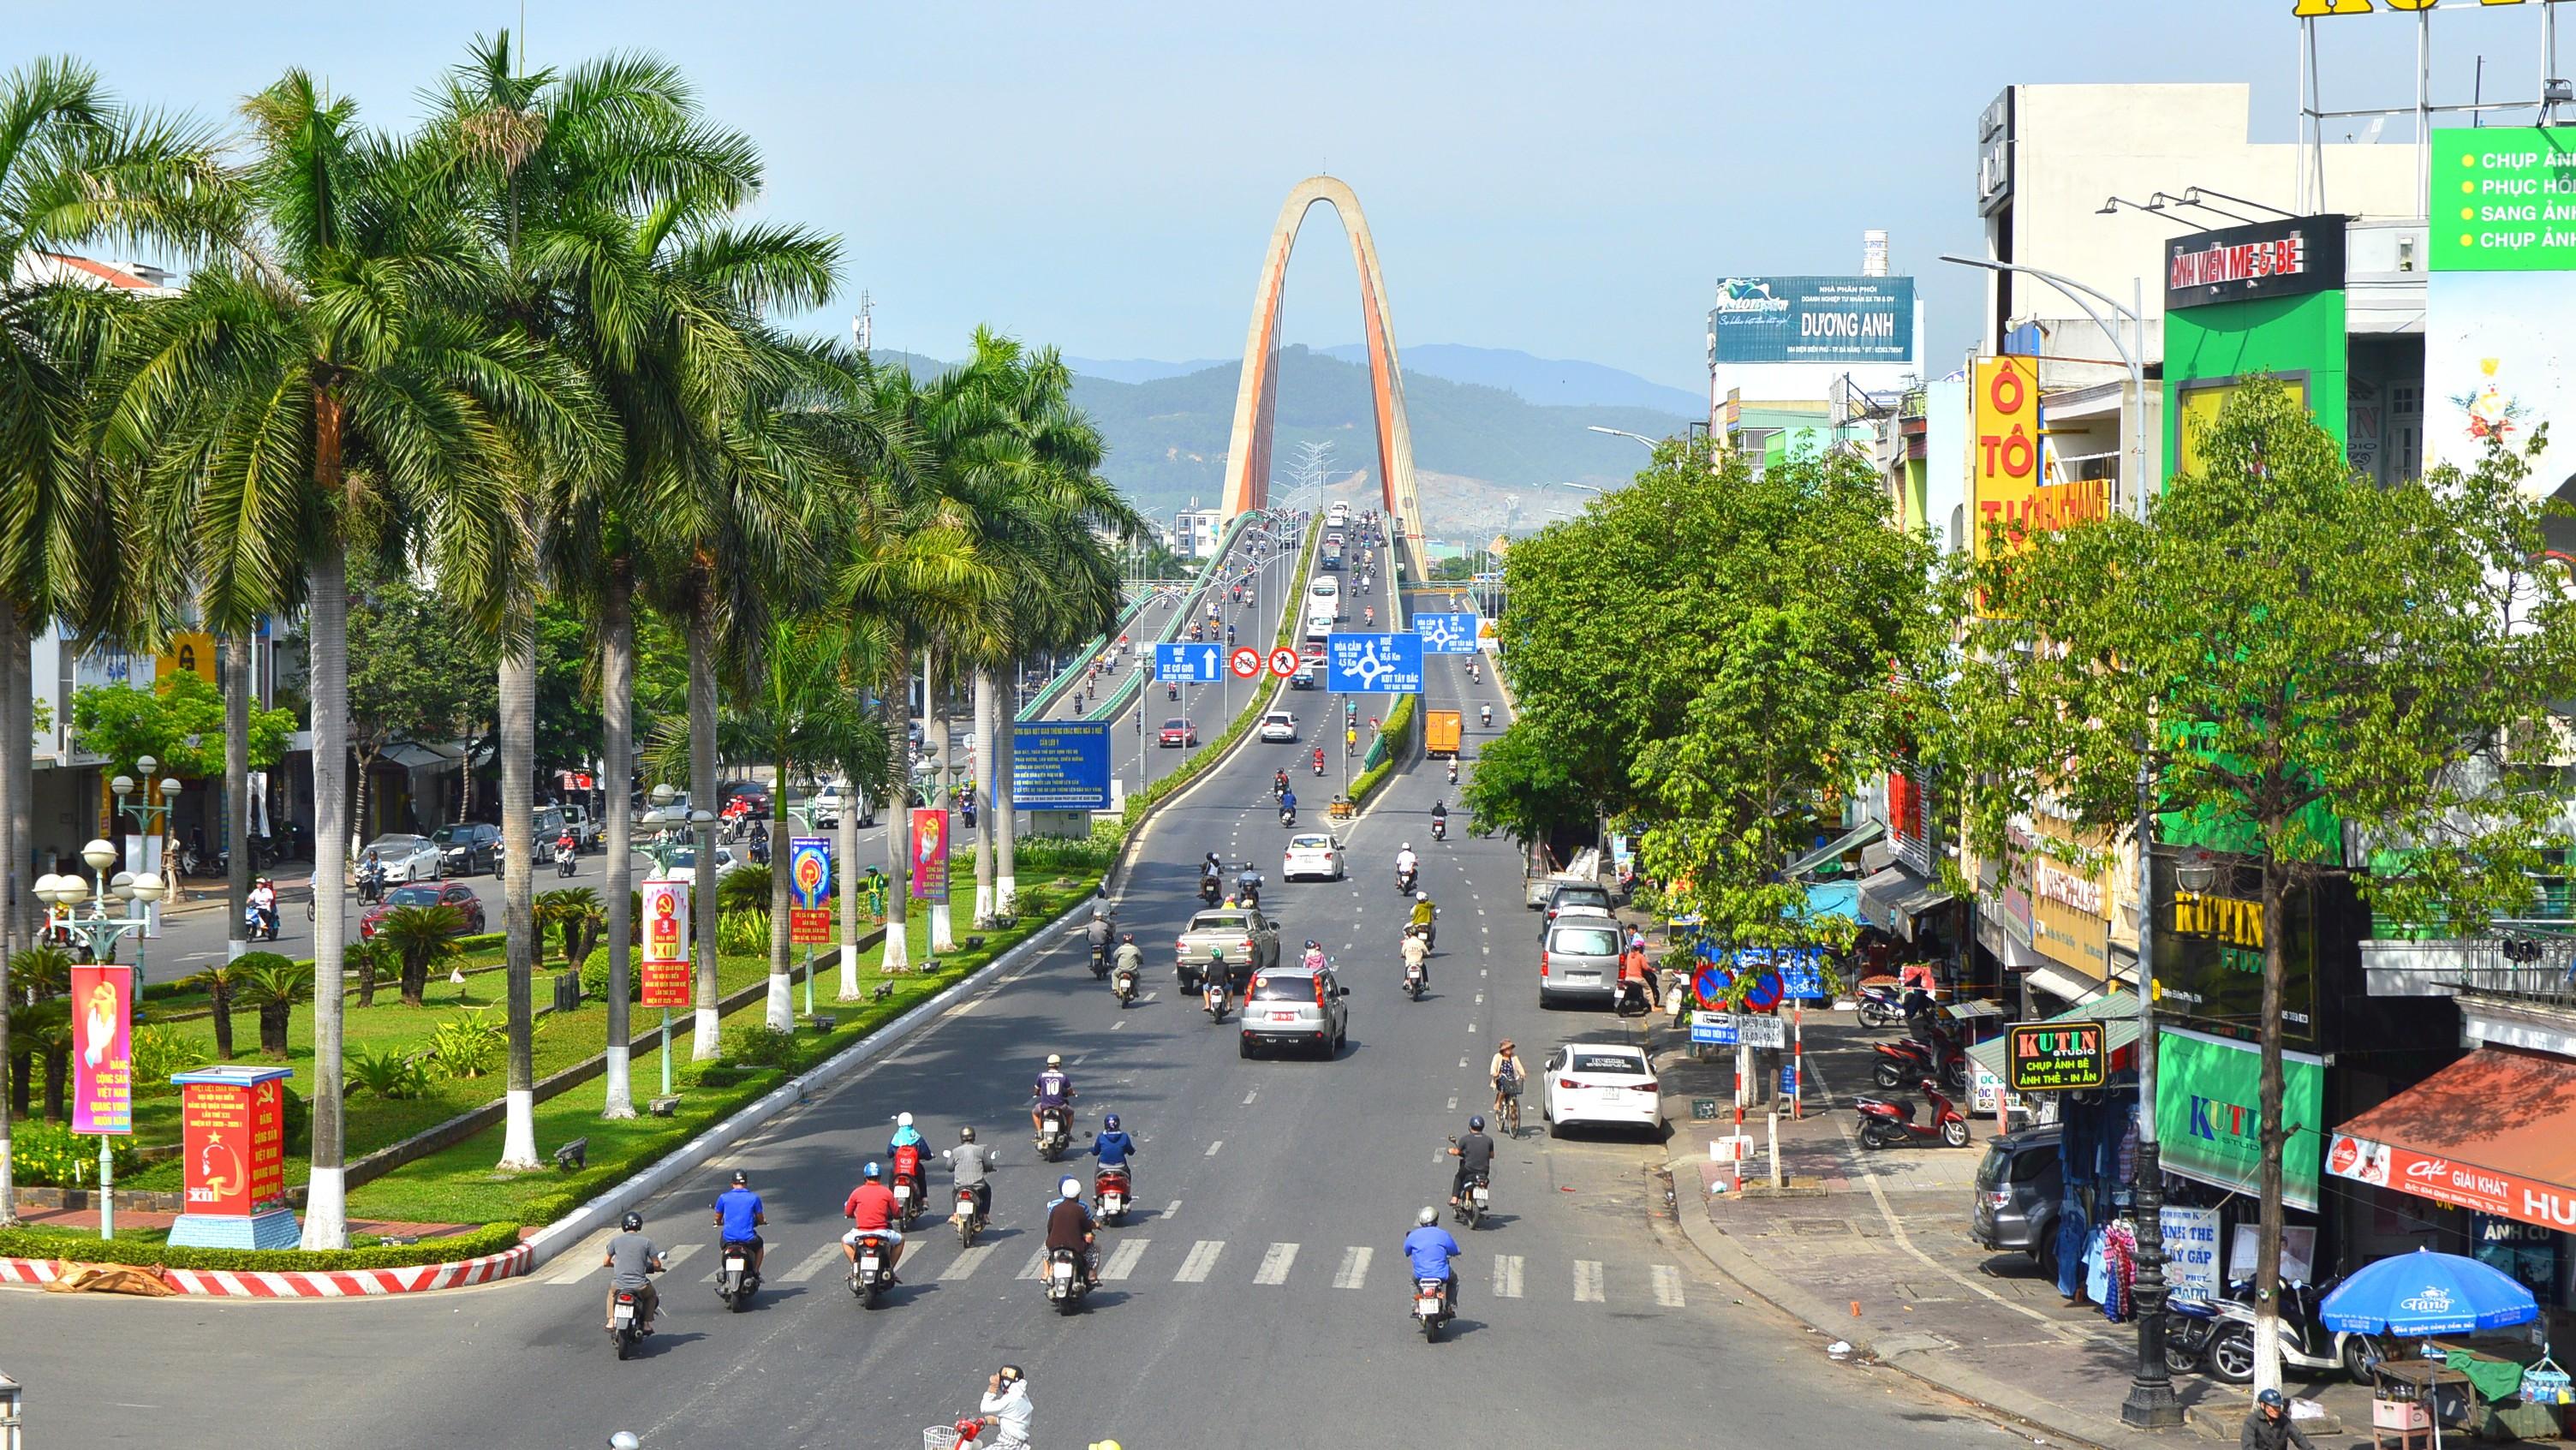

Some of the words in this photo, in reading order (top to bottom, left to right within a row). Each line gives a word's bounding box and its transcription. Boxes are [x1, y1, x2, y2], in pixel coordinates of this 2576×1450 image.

[2482, 152, 2537, 170] CHỤP
[2482, 179, 2537, 198] PHỤC
[2481, 206, 2537, 221] SANG
[2480, 232, 2536, 250] CHỤP
[2257, 243, 2271, 277] &
[2275, 231, 2299, 275] BÉ
[1801, 312, 1858, 337] DƯƠNG
[1861, 313, 1893, 337] ANH
[1849, 345, 1860, 354] NẴNG
[1991, 361, 2024, 413] Ô
[1981, 424, 2034, 479] TÔ
[1348, 640, 1362, 651] CẦM
[1380, 635, 1392, 646] HUẾ
[1173, 645, 1185, 656] HUẾ
[1392, 653, 1401, 661] Km
[1163, 664, 1172, 673] XE
[1172, 664, 1181, 673] CƠ
[1182, 662, 1194, 673] GIỚI
[1348, 658, 1357, 667] Km
[1394, 672, 1405, 683] TÂY
[1406, 671, 1418, 683] BẮC
[2174, 891, 2263, 948] KUTIN
[2221, 947, 2267, 975] STUDI
[2018, 1030, 2097, 1058] KUTIN
[2053, 1048, 2096, 1057] STUDIO
[110, 1056, 128, 1070] ĐẢNG
[2026, 1061, 2053, 1072] CHỤP
[2054, 1057, 2075, 1069] ẢNH
[96, 1073, 114, 1084] CỘNG
[114, 1071, 128, 1083] SẢN
[2020, 1073, 2041, 1085] ẢNH
[2042, 1071, 2061, 1083] THẺ
[2070, 1073, 2080, 1083] IN
[97, 1085, 112, 1098] VIỆT
[113, 1088, 128, 1098] NAM
[1045, 1078, 1060, 1095] 10
[90, 1101, 111, 1113] QUANG
[2189, 1095, 2261, 1142] KUTI
[2221, 1137, 2260, 1151] STUD
[2406, 1159, 2448, 1182] Café
[2452, 1167, 2476, 1190] GIẢI
[2478, 1176, 2508, 1198] KHÁT
[2434, 1189, 2450, 1199] Điện
[2450, 1193, 2466, 1203] Biên
[2162, 1220, 2186, 1240] ẢNH
[2189, 1224, 2214, 1242] THẺ
[2484, 1220, 2523, 1240] ẢNH
[2162, 1245, 2184, 1262] ẤY
[2173, 1268, 2184, 1283] 5
